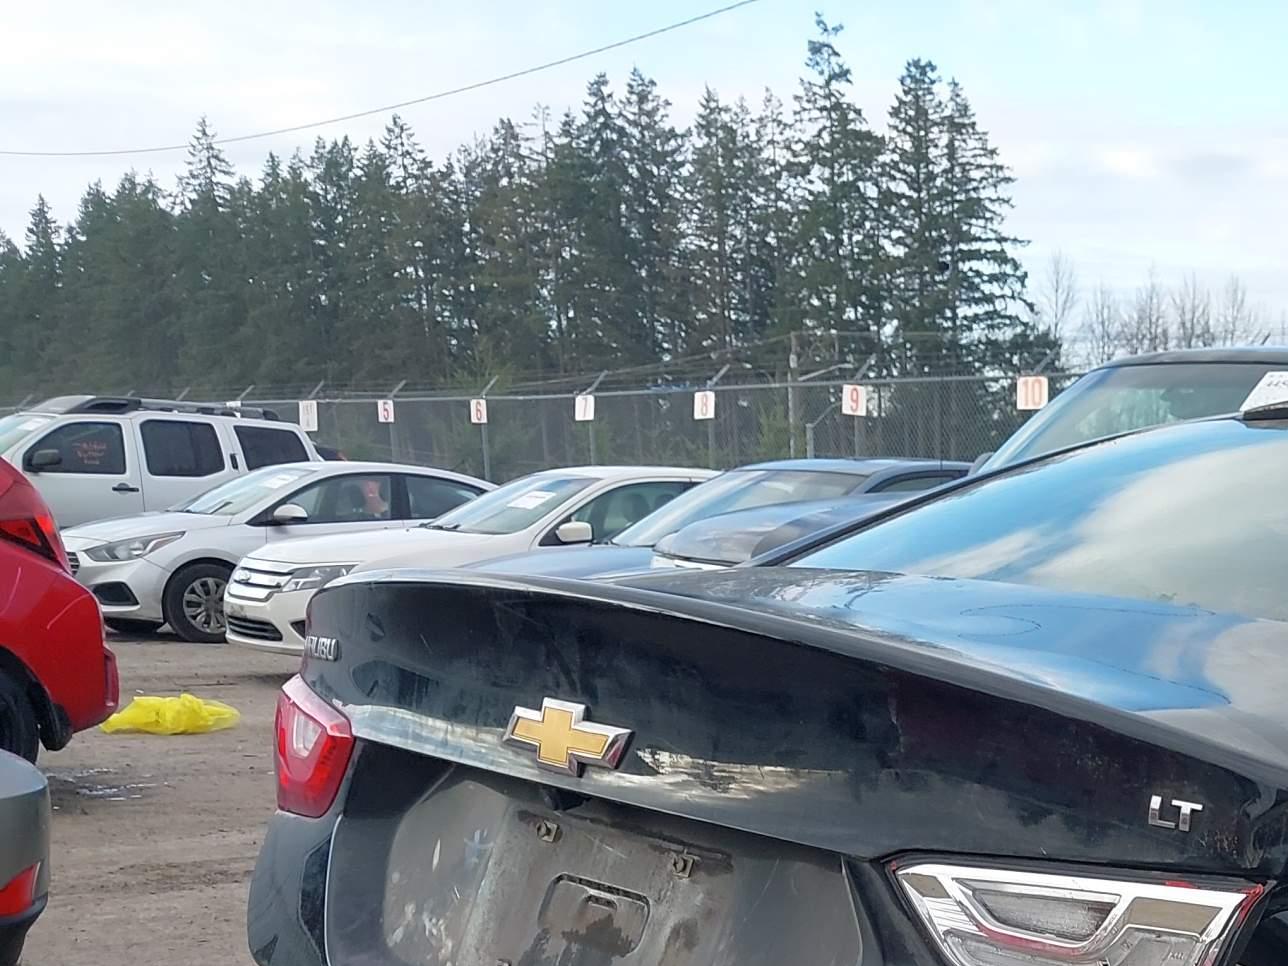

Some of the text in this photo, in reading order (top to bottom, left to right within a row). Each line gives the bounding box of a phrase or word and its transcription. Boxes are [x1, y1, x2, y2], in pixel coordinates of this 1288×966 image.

[699, 393, 709, 417] 8
[850, 387, 859, 413] 9
[1022, 378, 1042, 407] 10
[382, 401, 390, 421] 5
[475, 400, 483, 422] 6
[1148, 794, 1203, 832] LT
